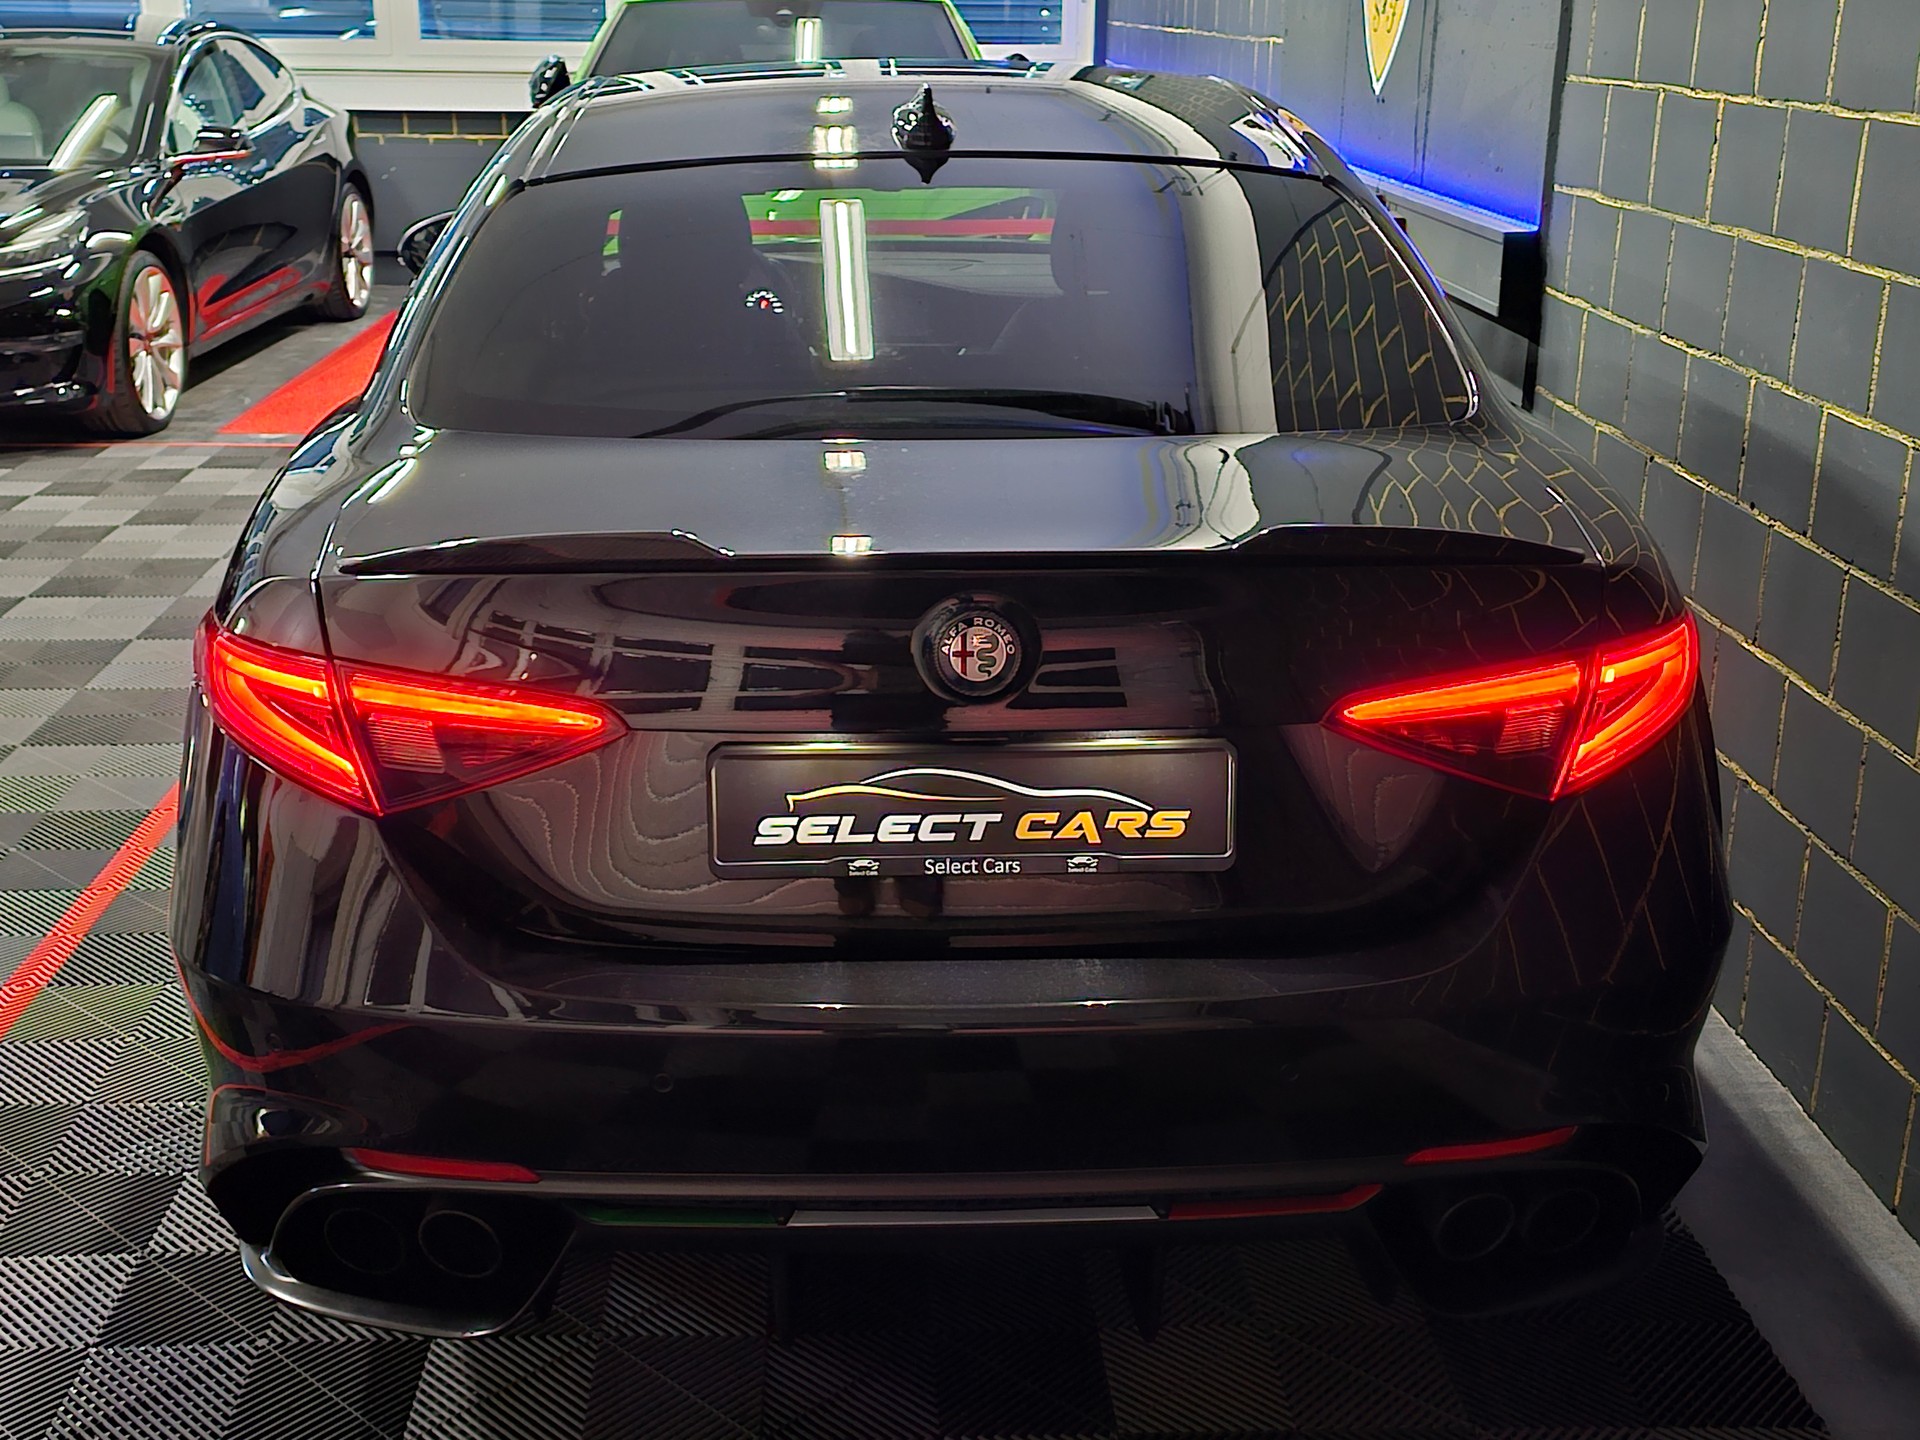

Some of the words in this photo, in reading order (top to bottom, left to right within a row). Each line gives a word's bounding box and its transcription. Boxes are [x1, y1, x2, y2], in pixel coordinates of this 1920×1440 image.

[941, 621, 968, 656] ALFA
[973, 616, 1016, 655] ROMEO
[753, 813, 1003, 846] SELECT
[1014, 810, 1192, 844] CARS
[924, 857, 979, 875] Select
[982, 857, 1021, 875] Cars
